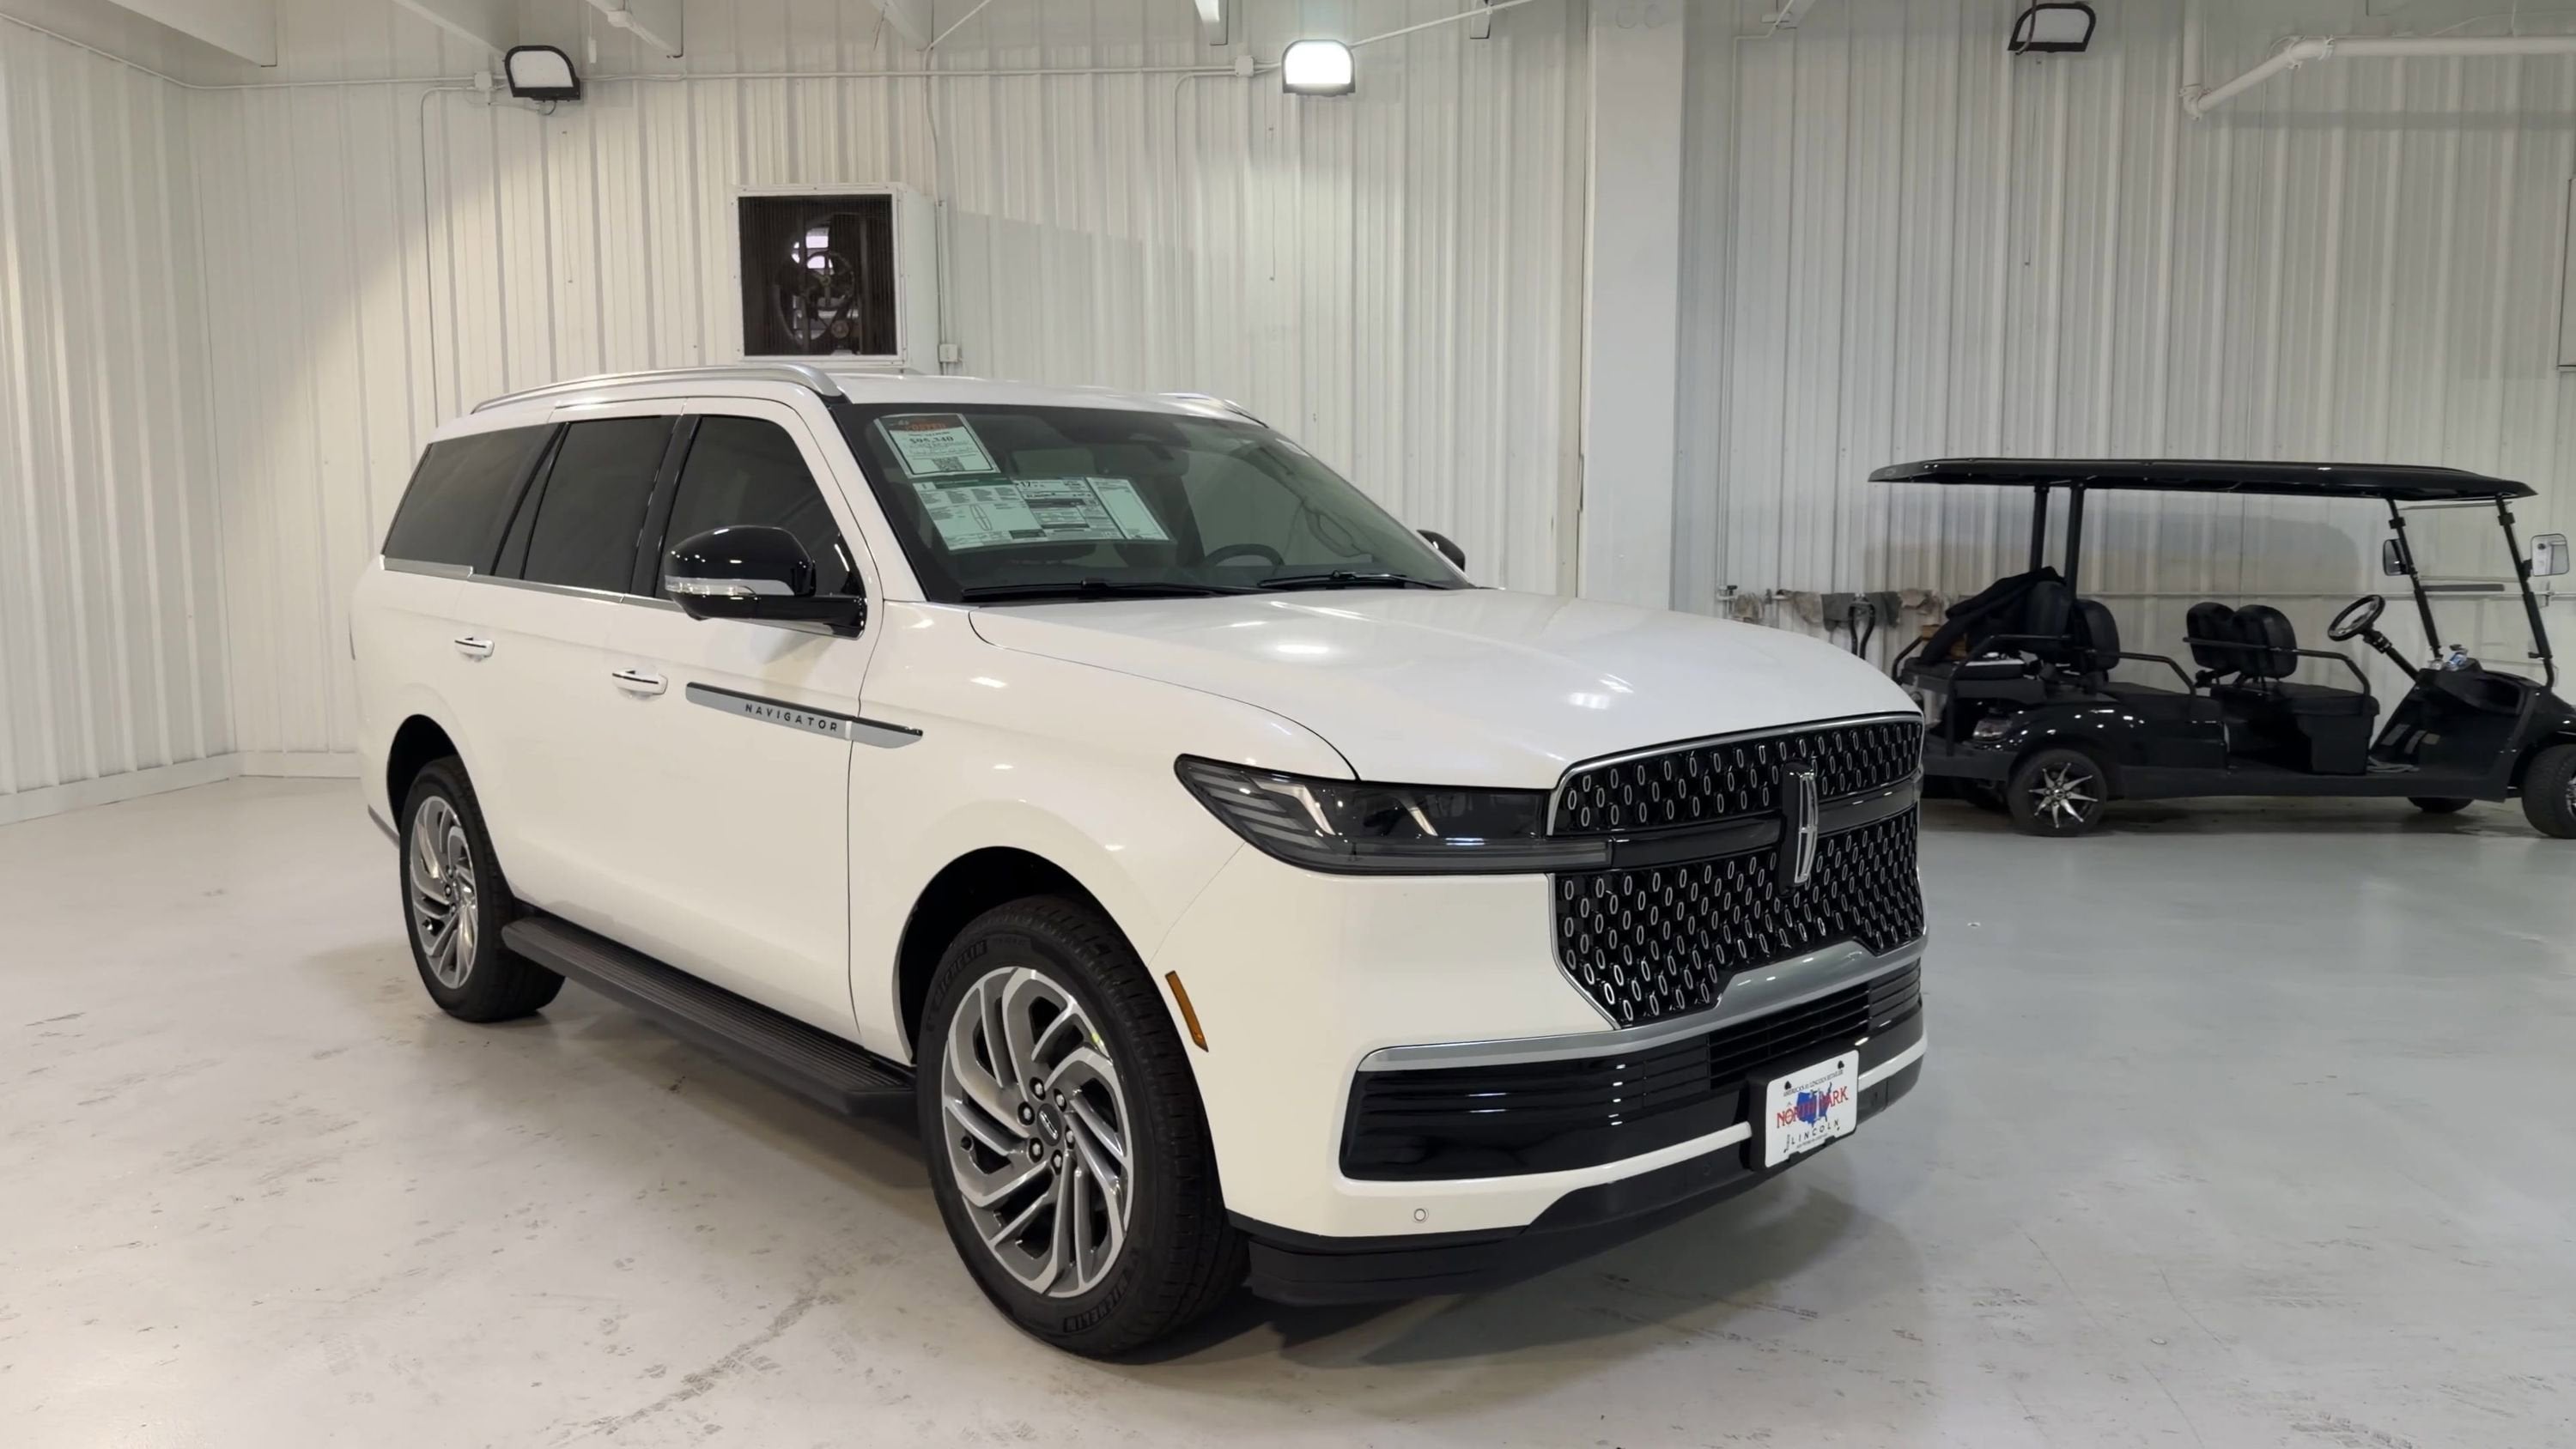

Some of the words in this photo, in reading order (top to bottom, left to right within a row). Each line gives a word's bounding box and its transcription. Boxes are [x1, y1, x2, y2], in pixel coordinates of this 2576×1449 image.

[744, 704, 837, 731] NAVIGATOR
[931, 939, 987, 1012] MICHELIN
[1777, 1102, 1817, 1128] NORTH
[1819, 1086, 1849, 1108] PARK
[1791, 1119, 1839, 1145] LINCOLN
